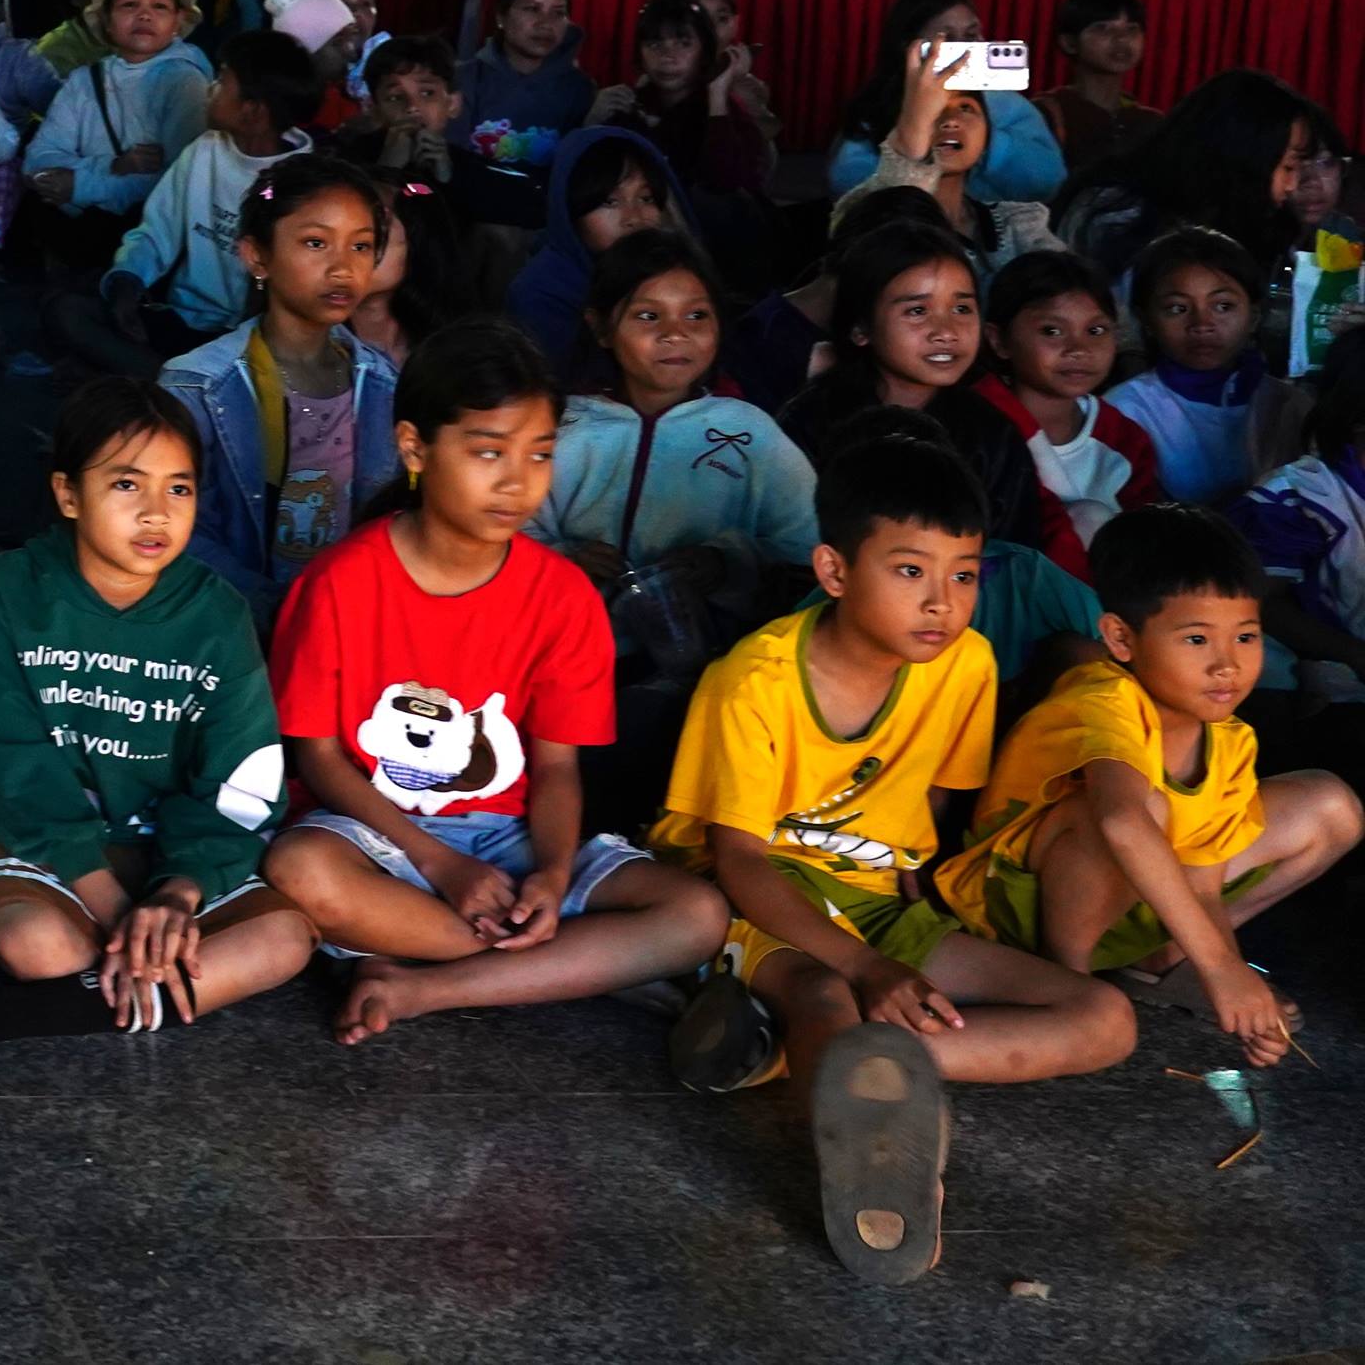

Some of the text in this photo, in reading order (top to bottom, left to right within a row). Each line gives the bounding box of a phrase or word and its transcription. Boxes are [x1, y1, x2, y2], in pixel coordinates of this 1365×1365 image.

[18, 645, 80, 672] nling
[82, 650, 139, 673] your
[144, 658, 199, 682] min
